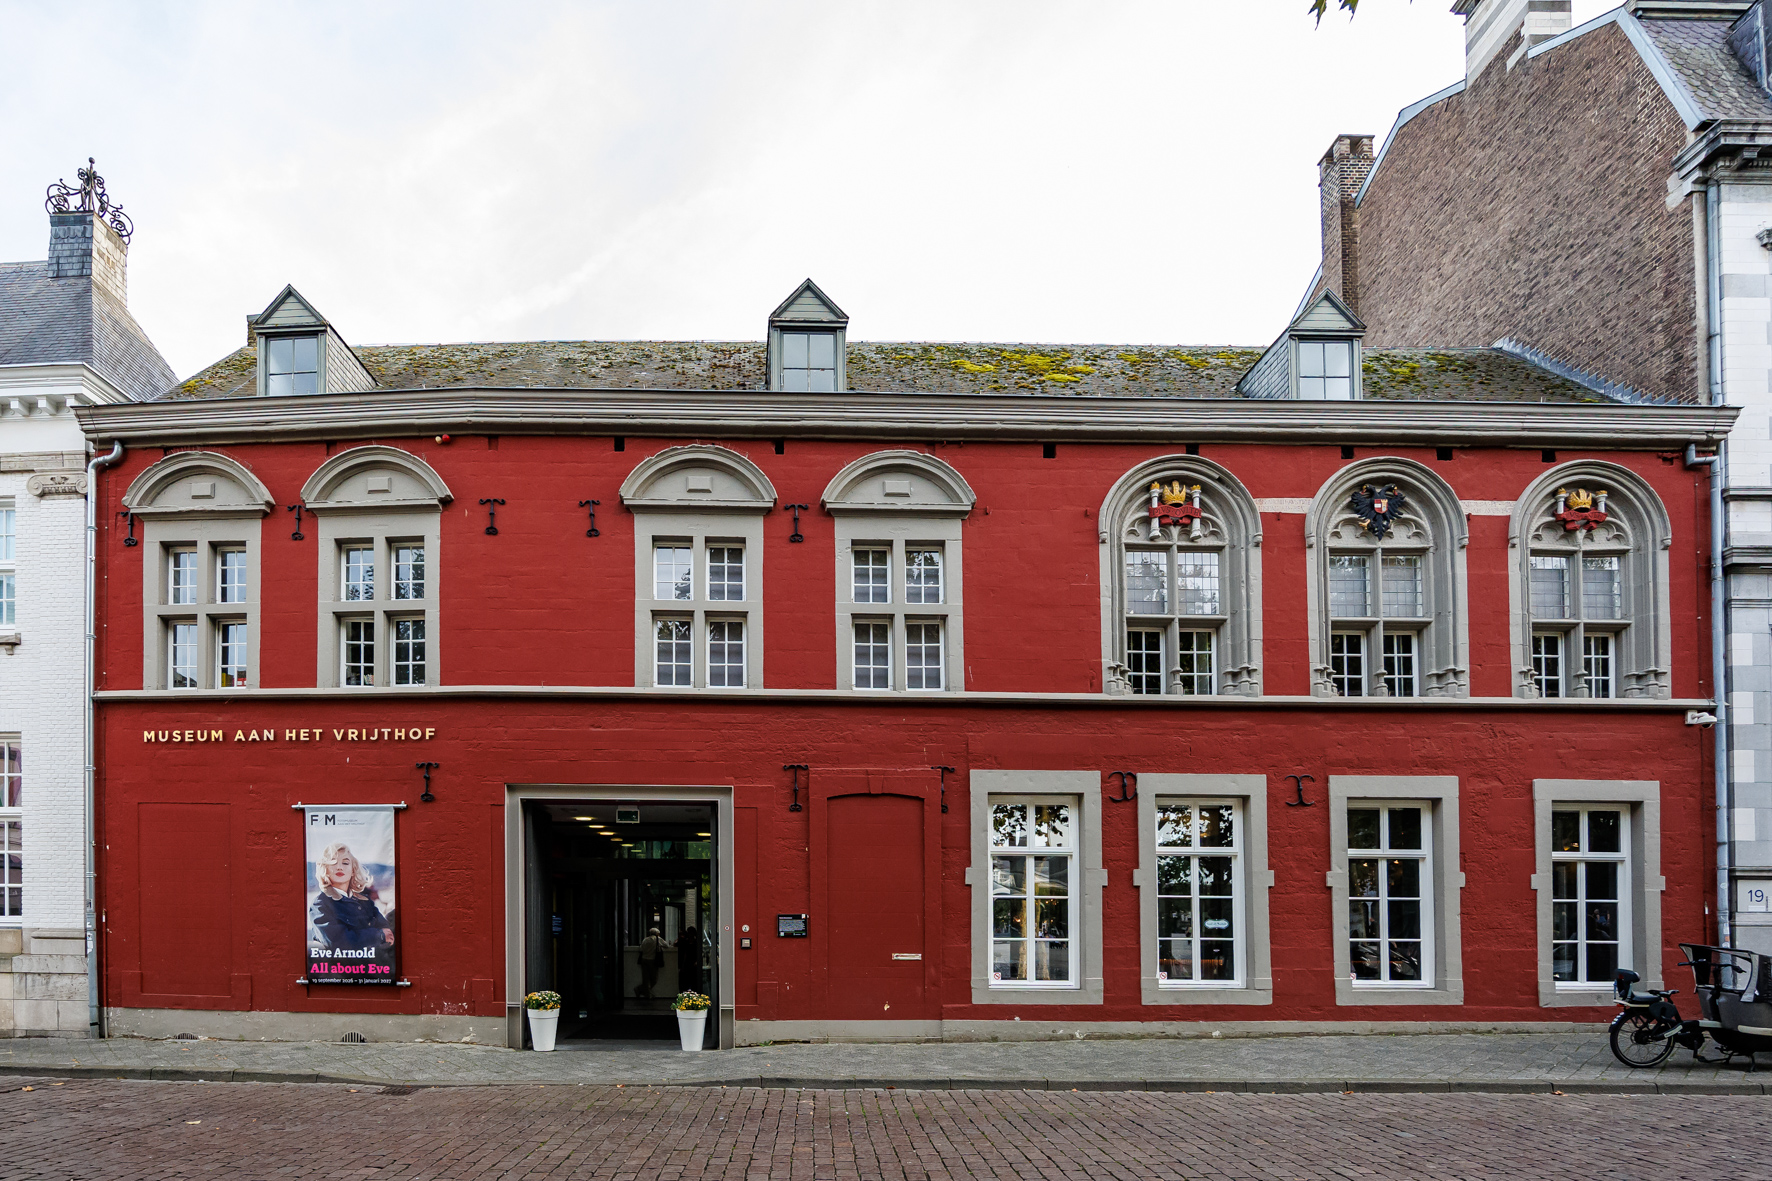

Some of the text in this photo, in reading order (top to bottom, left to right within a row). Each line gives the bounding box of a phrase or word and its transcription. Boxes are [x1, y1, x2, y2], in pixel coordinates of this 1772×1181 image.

[143, 728, 436, 743] MUSEUM AAN HET VRIJTHOF
[1747, 889, 1764, 903] 19
[310, 947, 376, 958] Eve Arnold
[310, 962, 390, 974] All about Eve
